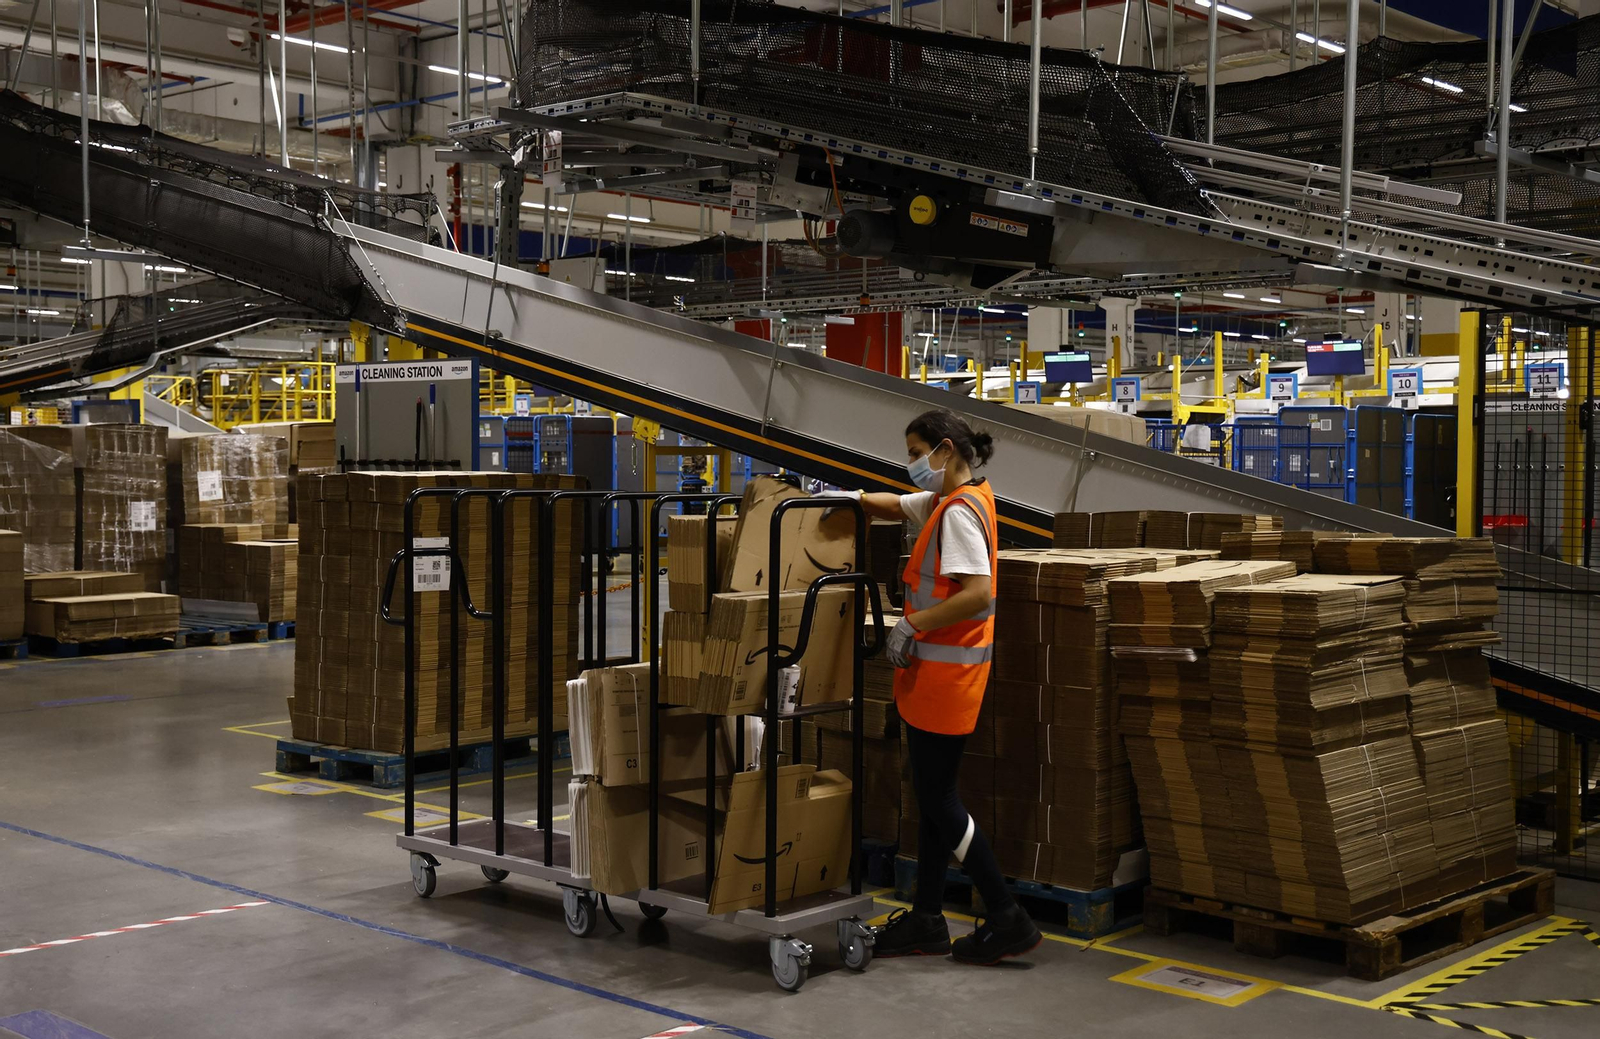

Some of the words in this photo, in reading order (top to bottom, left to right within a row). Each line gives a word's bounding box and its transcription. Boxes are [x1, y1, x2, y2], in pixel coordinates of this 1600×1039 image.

[1382, 308, 1388, 317] J
[1112, 323, 1118, 331] H
[362, 368, 405, 380] CLEANING
[407, 366, 443, 378] STATION
[1398, 378, 1411, 389] 10
[1536, 374, 1551, 384] 11
[1123, 386, 1129, 395] 8
[1278, 383, 1285, 393] 9
[1025, 389, 1030, 398] 7
[1511, 402, 1560, 413] CLEANING
[626, 759, 638, 769] C3
[752, 883, 762, 892] E3
